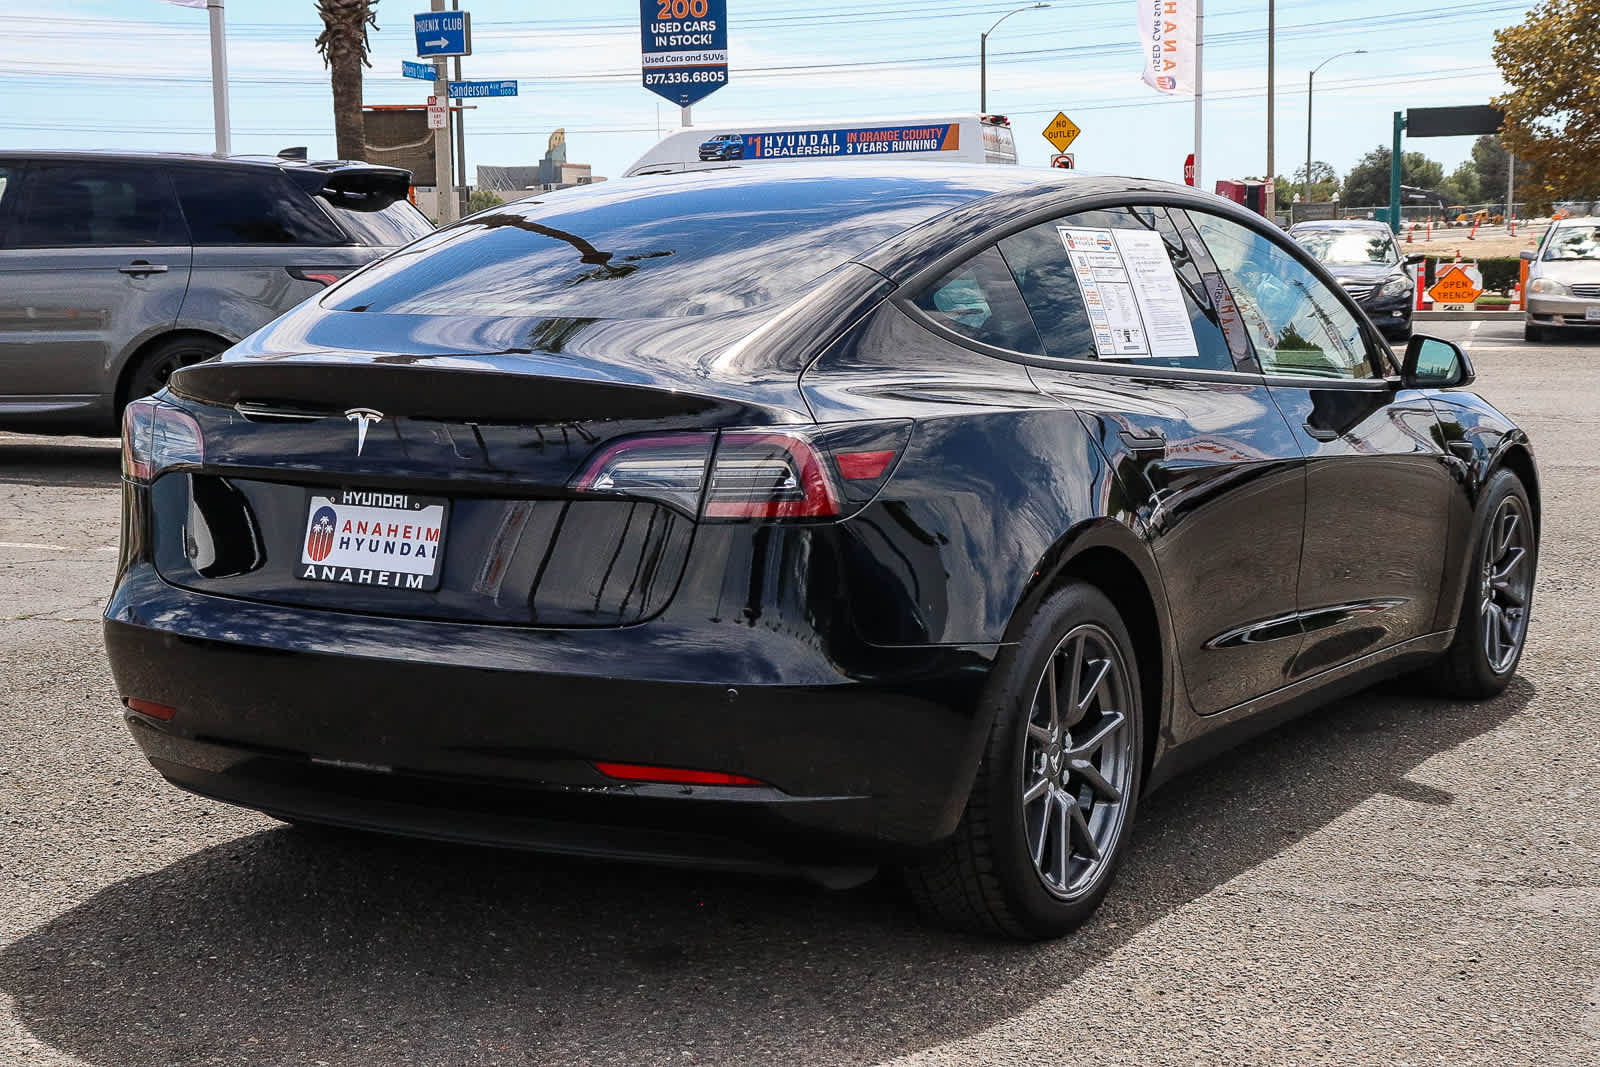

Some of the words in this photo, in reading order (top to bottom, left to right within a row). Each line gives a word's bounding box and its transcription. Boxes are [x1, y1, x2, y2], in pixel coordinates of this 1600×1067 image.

[657, 0, 708, 19] 200
[416, 18, 440, 33] PHOENIX
[442, 17, 462, 31] CLUB
[650, 22, 680, 33] USED
[683, 20, 716, 32] CARS
[656, 36, 667, 46] IN
[670, 34, 712, 46] STOCK!
[645, 56, 664, 64] Used
[685, 54, 701, 62] and
[646, 72, 725, 85] 877.336.6805
[449, 84, 488, 97] Sanderson
[1056, 120, 1066, 128] NO
[764, 133, 837, 148] HYUNDAI
[847, 132, 857, 143] IN
[860, 130, 900, 143] ORANGE
[902, 128, 943, 140] COUNTY
[1048, 130, 1075, 139] OUTLET
[764, 145, 840, 157] DEALERSHIP
[846, 143, 852, 153] 3
[856, 141, 889, 153] YEARS
[892, 139, 938, 151] RUNNING
[1443, 281, 1468, 289] OPEN
[1438, 291, 1473, 299] TRENCH
[342, 491, 408, 509] HYUNDAI
[342, 520, 440, 542] ANAHEIM
[339, 536, 437, 560] HYUNDAI
[303, 565, 424, 589] ANAHEIM
